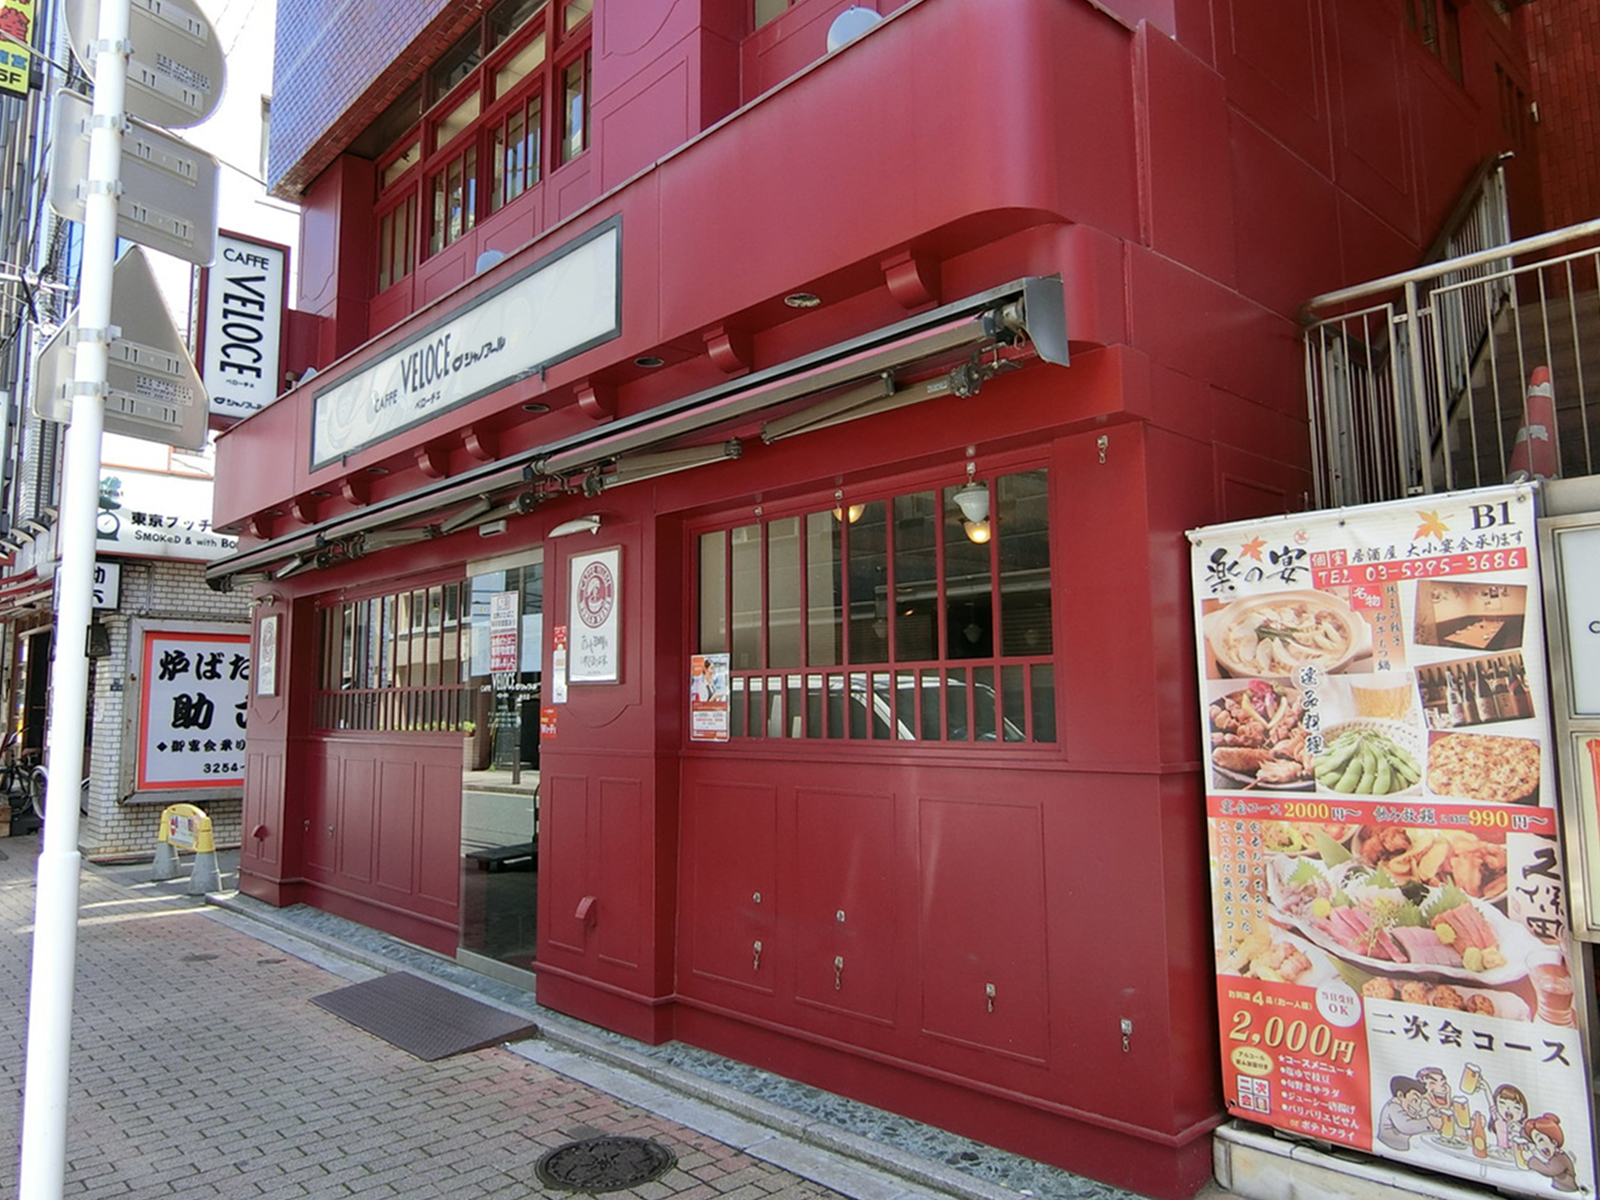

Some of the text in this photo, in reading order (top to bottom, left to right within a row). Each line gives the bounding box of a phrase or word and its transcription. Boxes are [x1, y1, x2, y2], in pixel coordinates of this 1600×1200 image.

[223, 248, 269, 271] CAFFE
[219, 276, 266, 379] VELOCE
[374, 333, 451, 413] CAFFE VELOCE
[1469, 501, 1515, 531] B1
[185, 538, 192, 546] &
[196, 538, 217, 548] with
[1311, 531, 1523, 568] 個室 居酒屋 大小宴会承ります
[1318, 551, 1519, 585] TEL 03-5295-3686
[1352, 586, 1381, 607] 名物
[158, 650, 250, 681] 炉ばた
[1328, 1003, 1349, 1017] OK
[1229, 1010, 1357, 1064] 2,000円
[1371, 1011, 1572, 1068] 二次会コース
